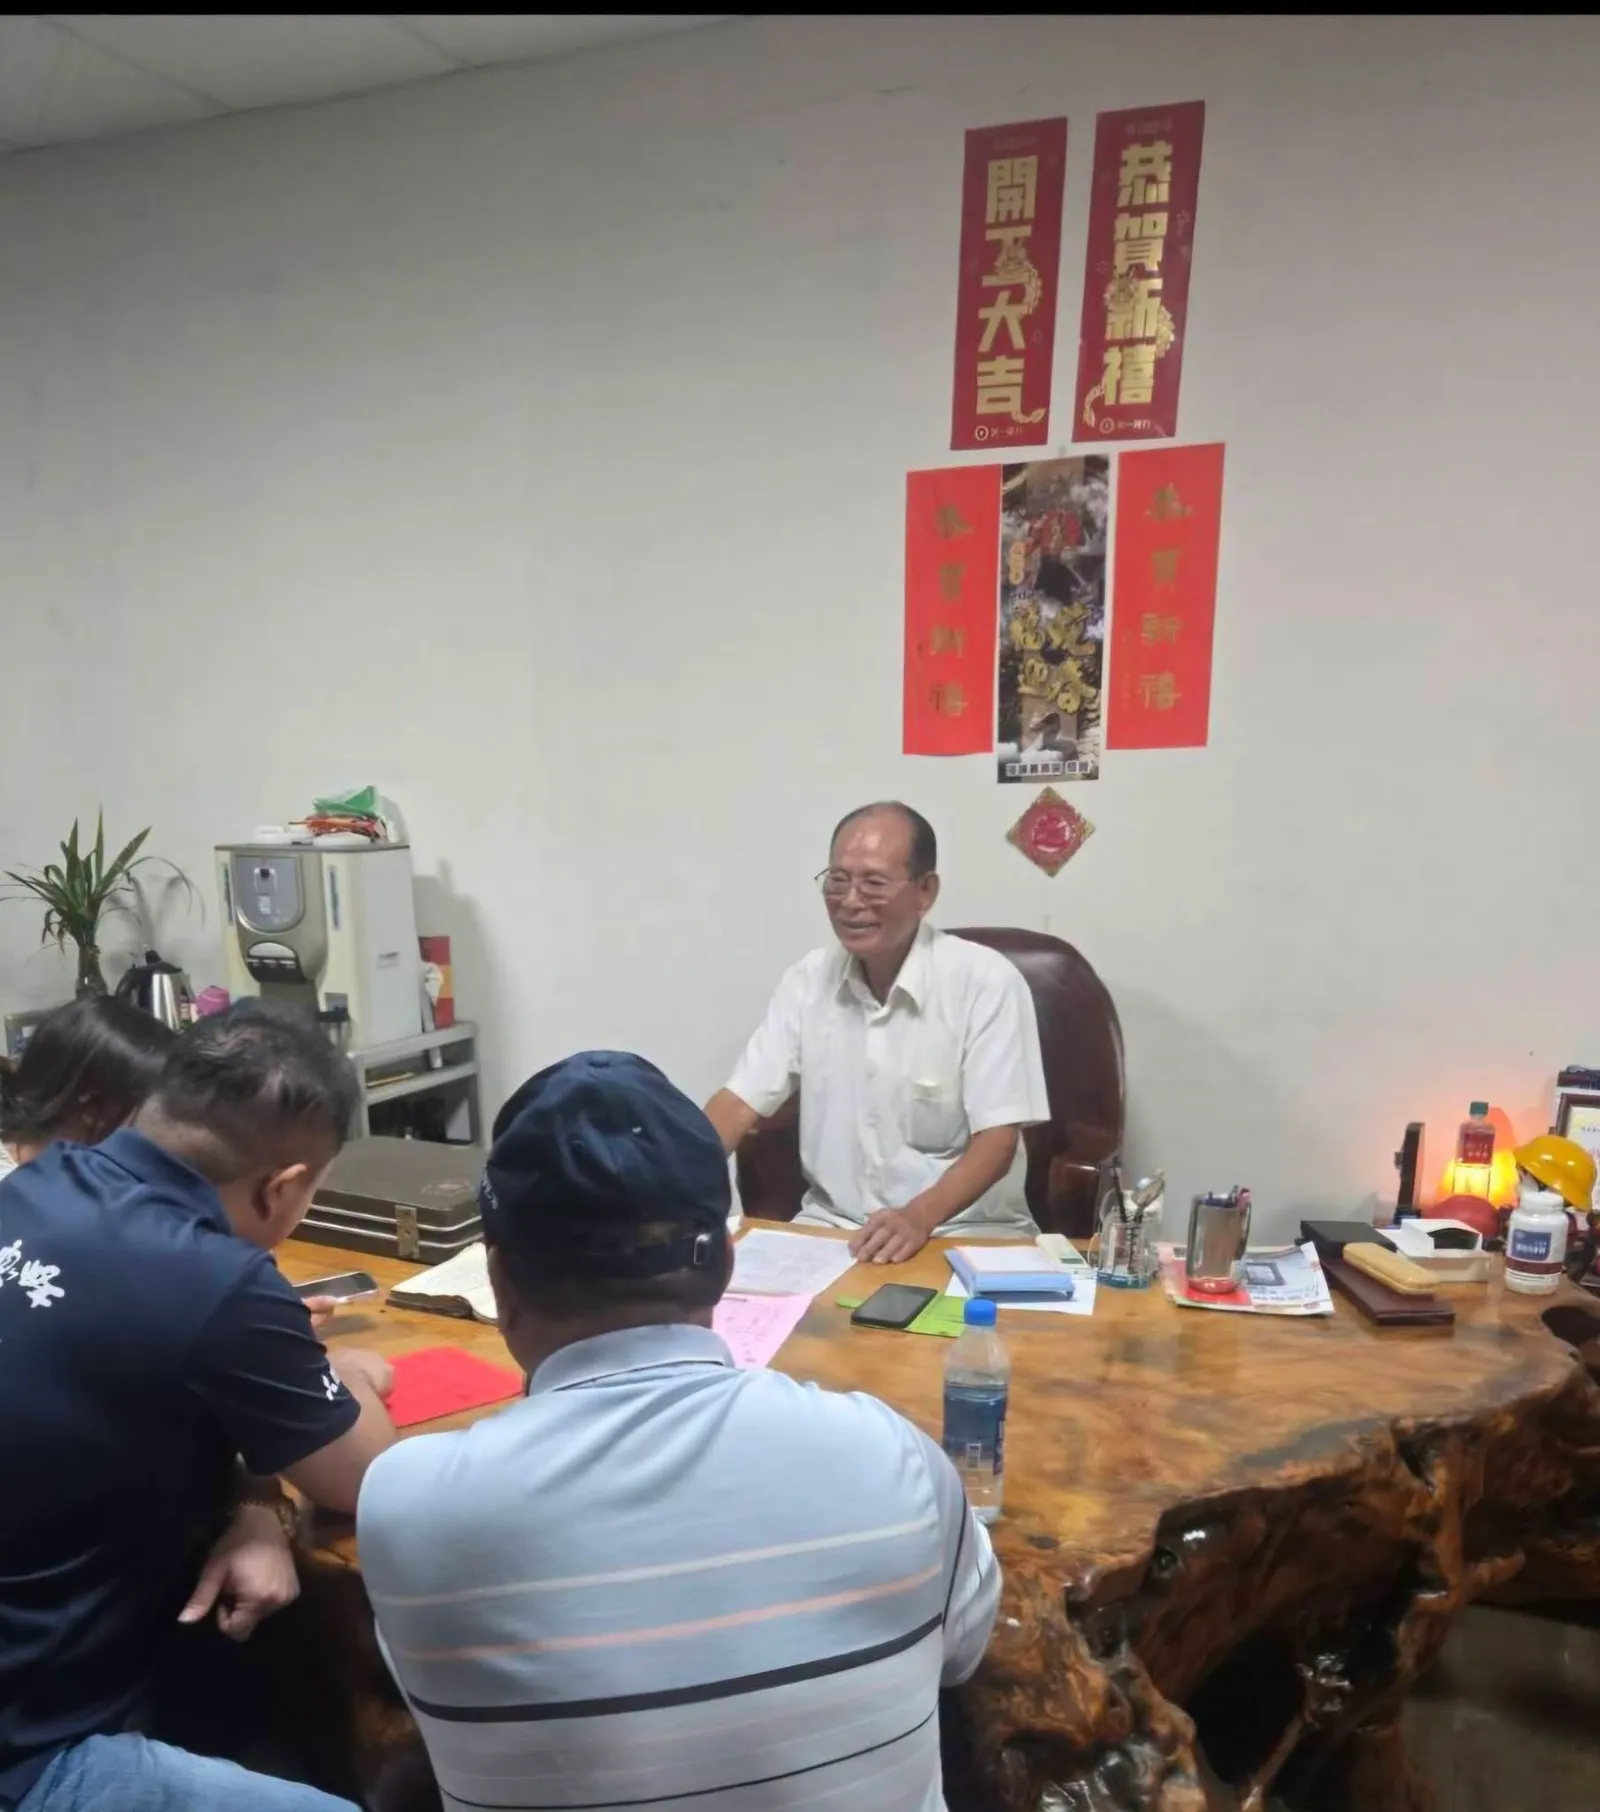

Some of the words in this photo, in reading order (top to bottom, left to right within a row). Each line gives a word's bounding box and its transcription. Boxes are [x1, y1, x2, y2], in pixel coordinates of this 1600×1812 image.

[975, 155, 1039, 416] 開工大吉
[1104, 139, 1174, 406] 恭賀新禧
